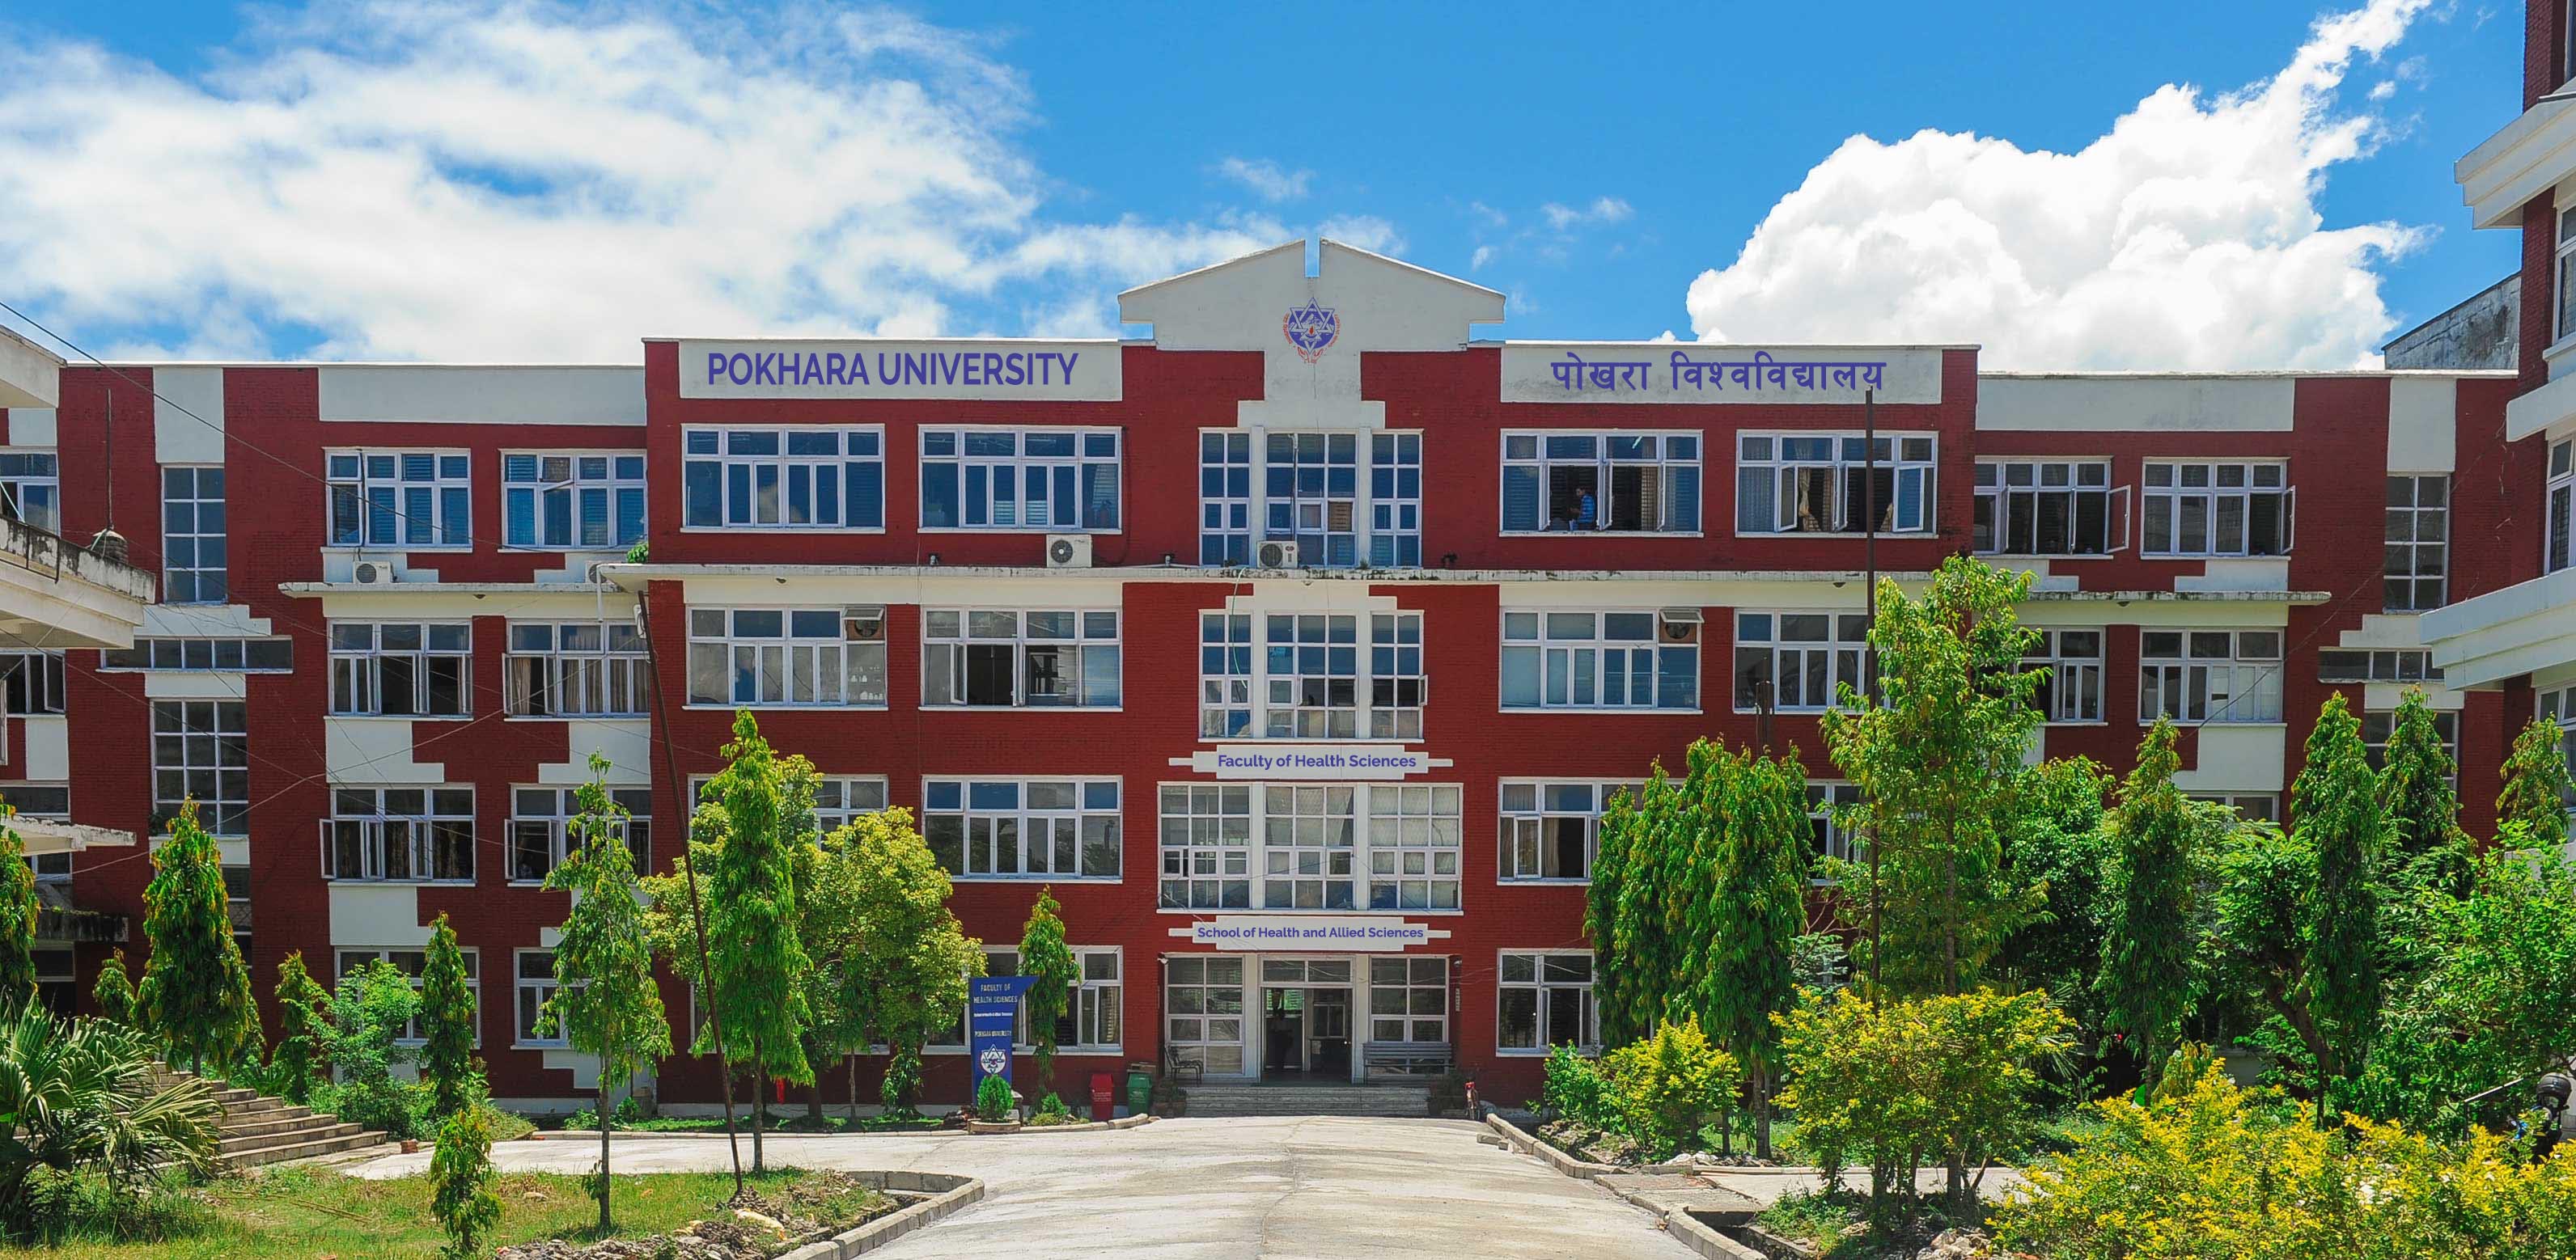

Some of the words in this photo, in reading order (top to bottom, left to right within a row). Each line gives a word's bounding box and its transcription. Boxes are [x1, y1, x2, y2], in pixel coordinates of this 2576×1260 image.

[708, 353, 870, 385] POKHARA
[879, 353, 1078, 385] UNIVERSITY
[1551, 352, 1652, 391] पोखरा
[1671, 351, 1888, 390] विश्वविद्यालय
[1218, 755, 1273, 770] Faculty
[1276, 755, 1292, 767] of
[1295, 755, 1345, 767] Health
[1349, 755, 1417, 767] Sciences
[1197, 927, 1241, 938] School
[1244, 927, 1256, 938] of
[1259, 927, 1300, 938] Health
[1303, 927, 1327, 938] and
[1329, 927, 1366, 938] Allied
[1369, 927, 1424, 938] Sciences
[981, 983, 1002, 992] FACULTY
[1004, 983, 1010, 992] OF
[973, 996, 992, 1004] HEALTH
